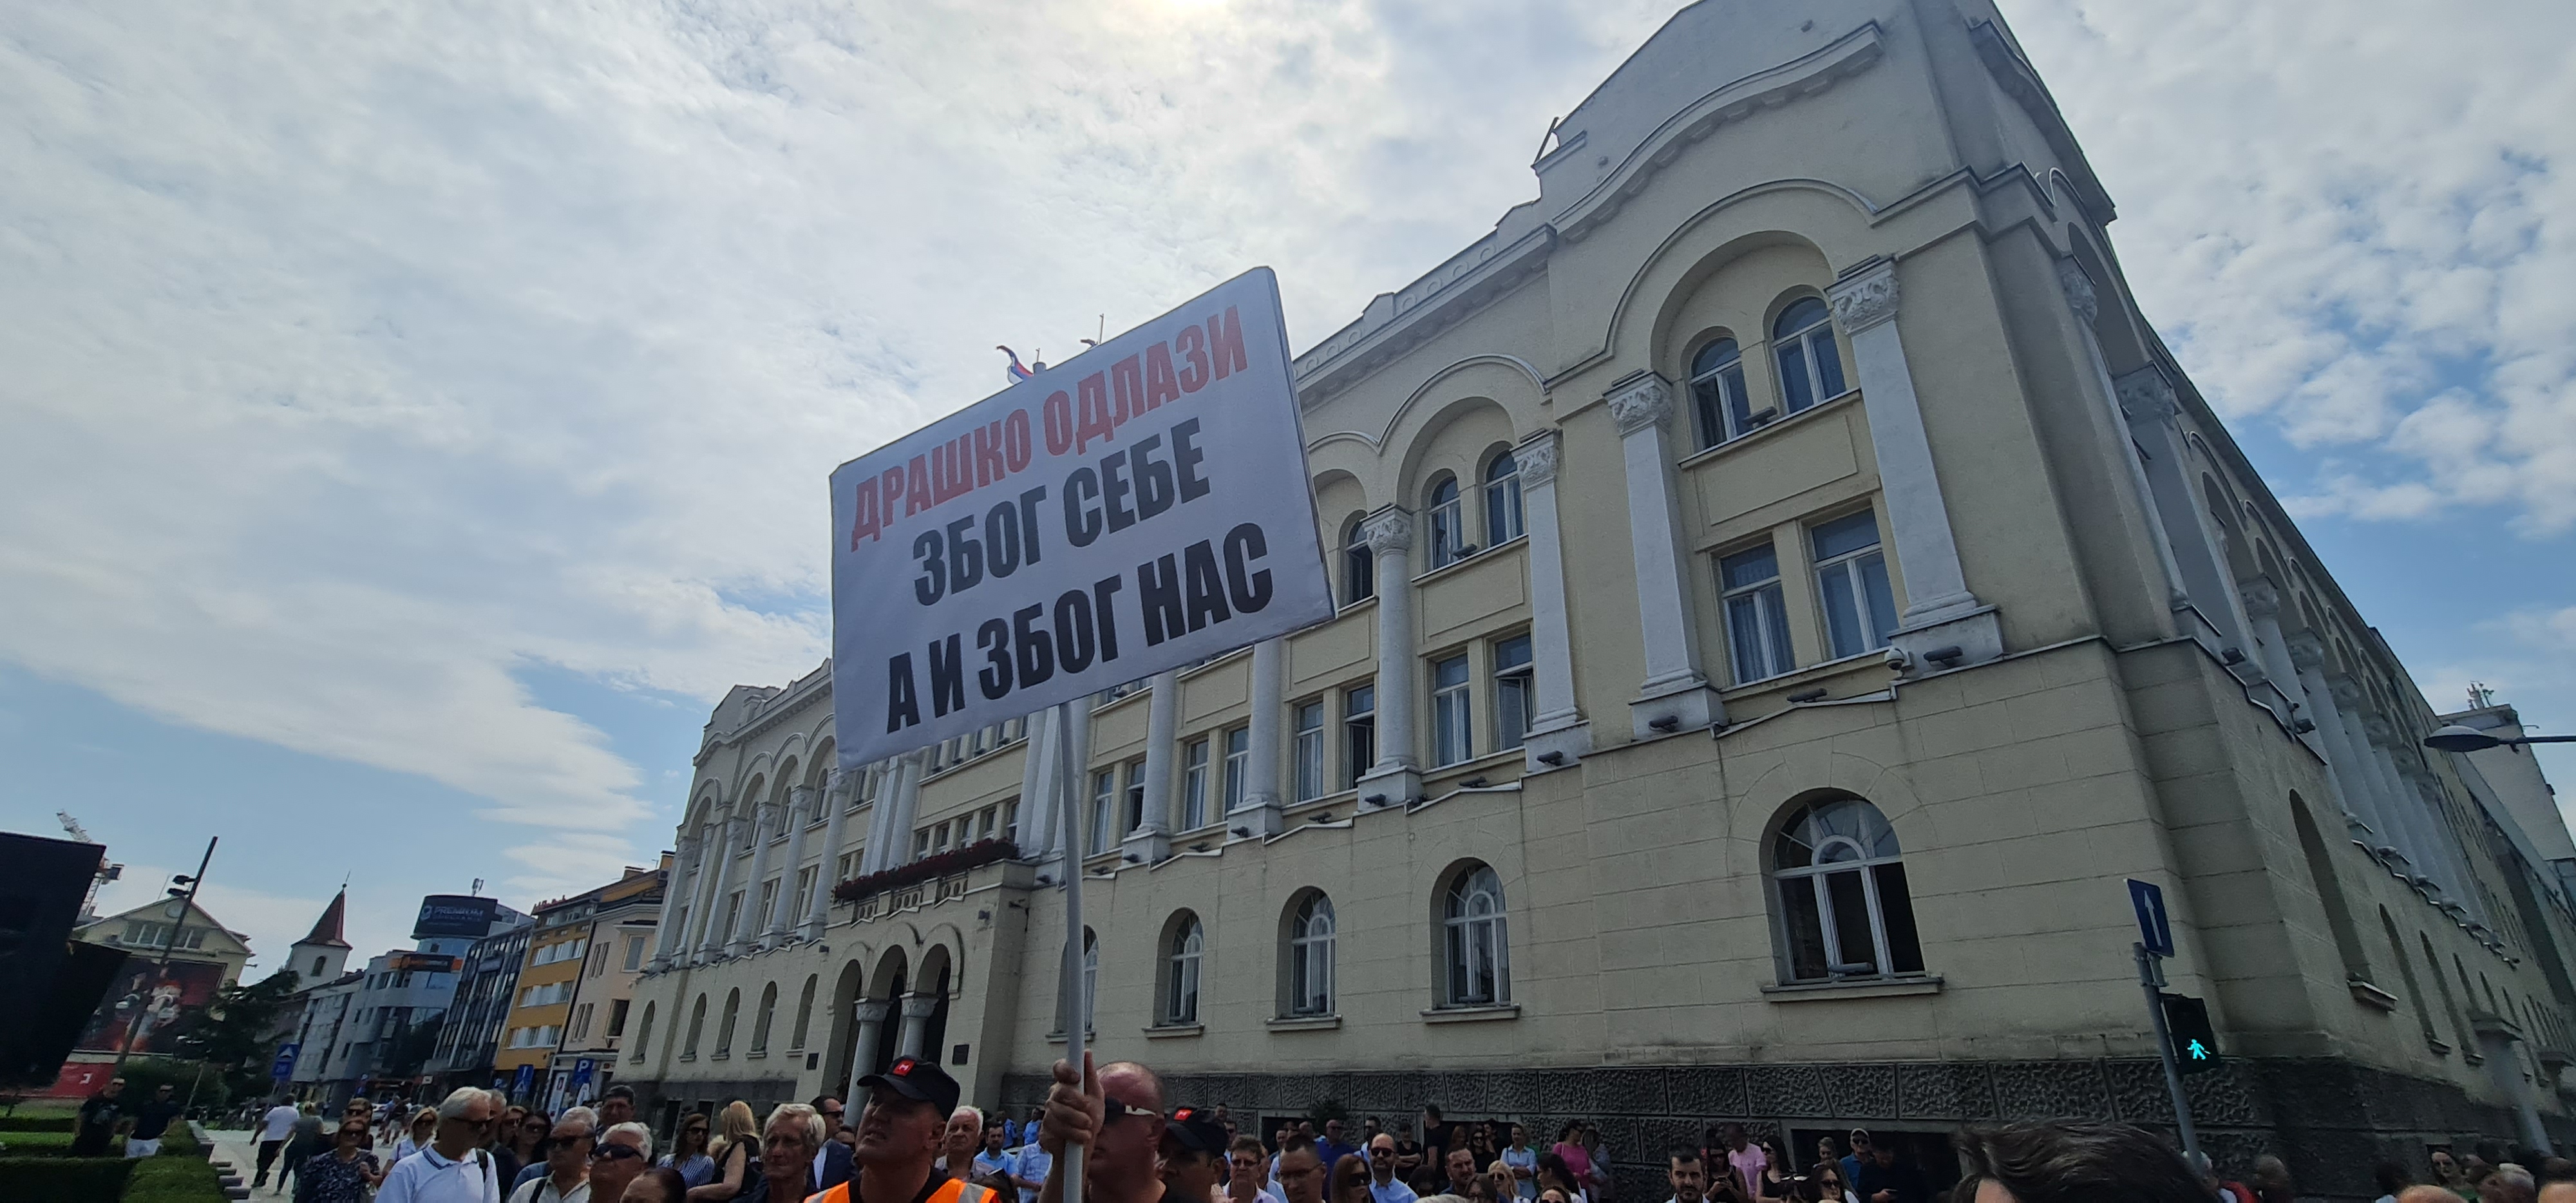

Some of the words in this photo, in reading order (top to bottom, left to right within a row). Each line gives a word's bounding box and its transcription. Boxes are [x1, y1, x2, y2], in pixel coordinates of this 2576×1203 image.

[850, 408, 1032, 553] ДРАШКО
[1042, 305, 1248, 456] ОДЛАЗИ
[912, 484, 1047, 607] ЗБОГ
[1063, 416, 1211, 548] СЕБЕ
[886, 651, 921, 734] А
[928, 632, 965, 718] И
[976, 573, 1122, 700] ЗБОГ
[1137, 522, 1274, 648] НАС
[578, 1059, 590, 1072] P
